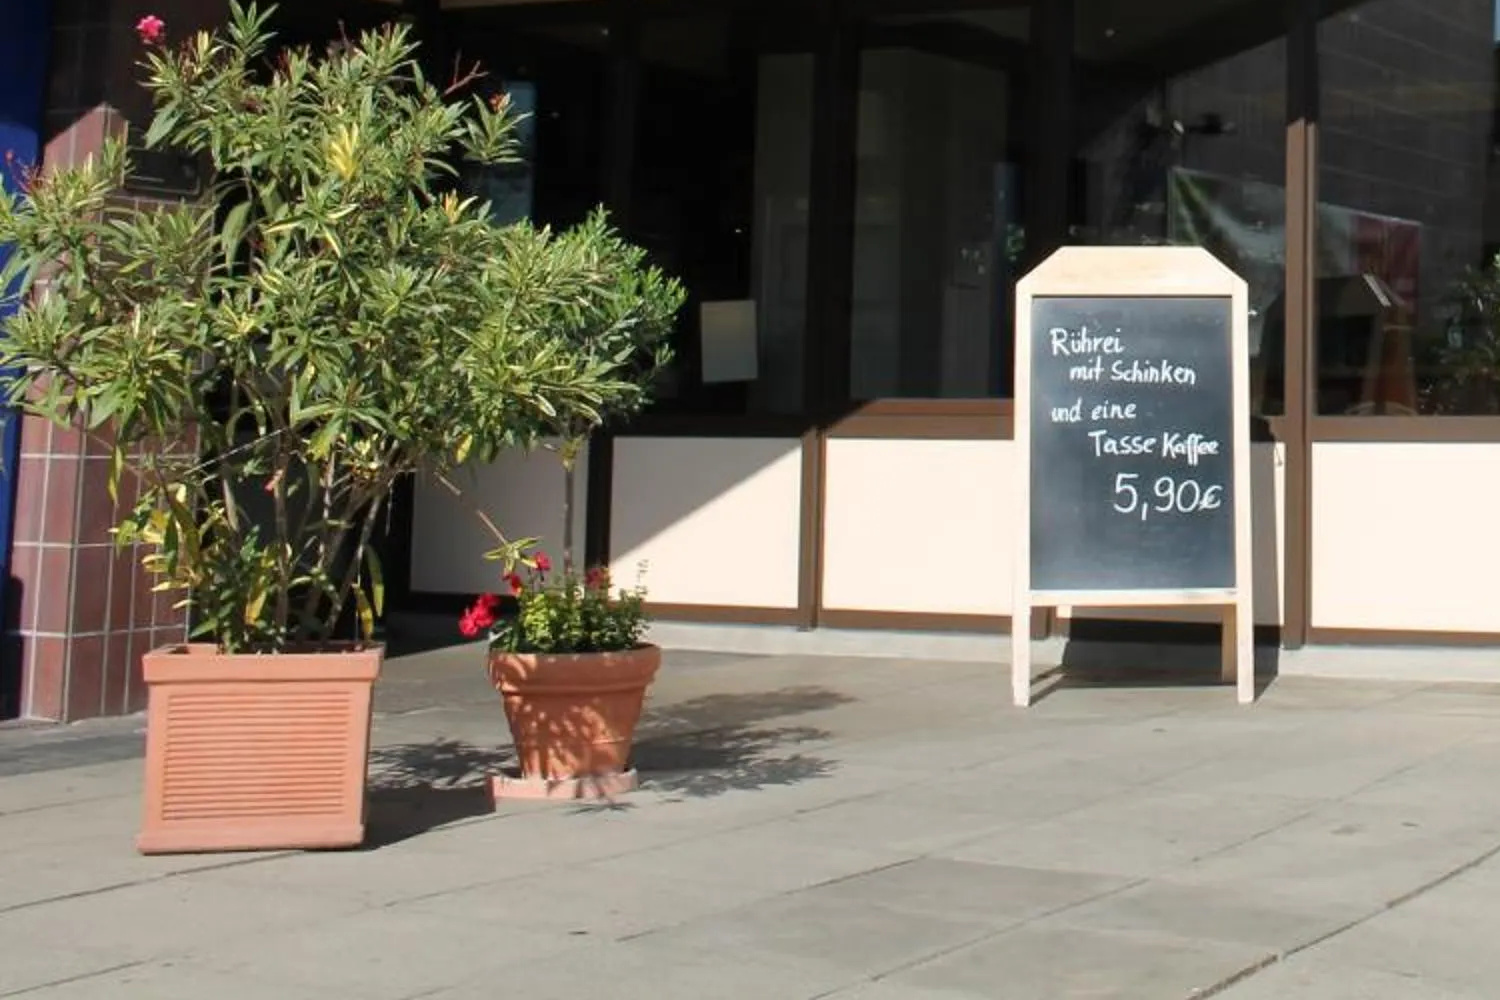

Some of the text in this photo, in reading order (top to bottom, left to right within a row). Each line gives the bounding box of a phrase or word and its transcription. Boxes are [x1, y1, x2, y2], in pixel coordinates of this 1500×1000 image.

[1050, 326, 1125, 356] Rührei
[1069, 355, 1197, 385] mit Schinken
[1051, 396, 1137, 423] und eine
[1087, 429, 1219, 466] Tasse Kaffee
[1113, 473, 1223, 521] 5,90€
